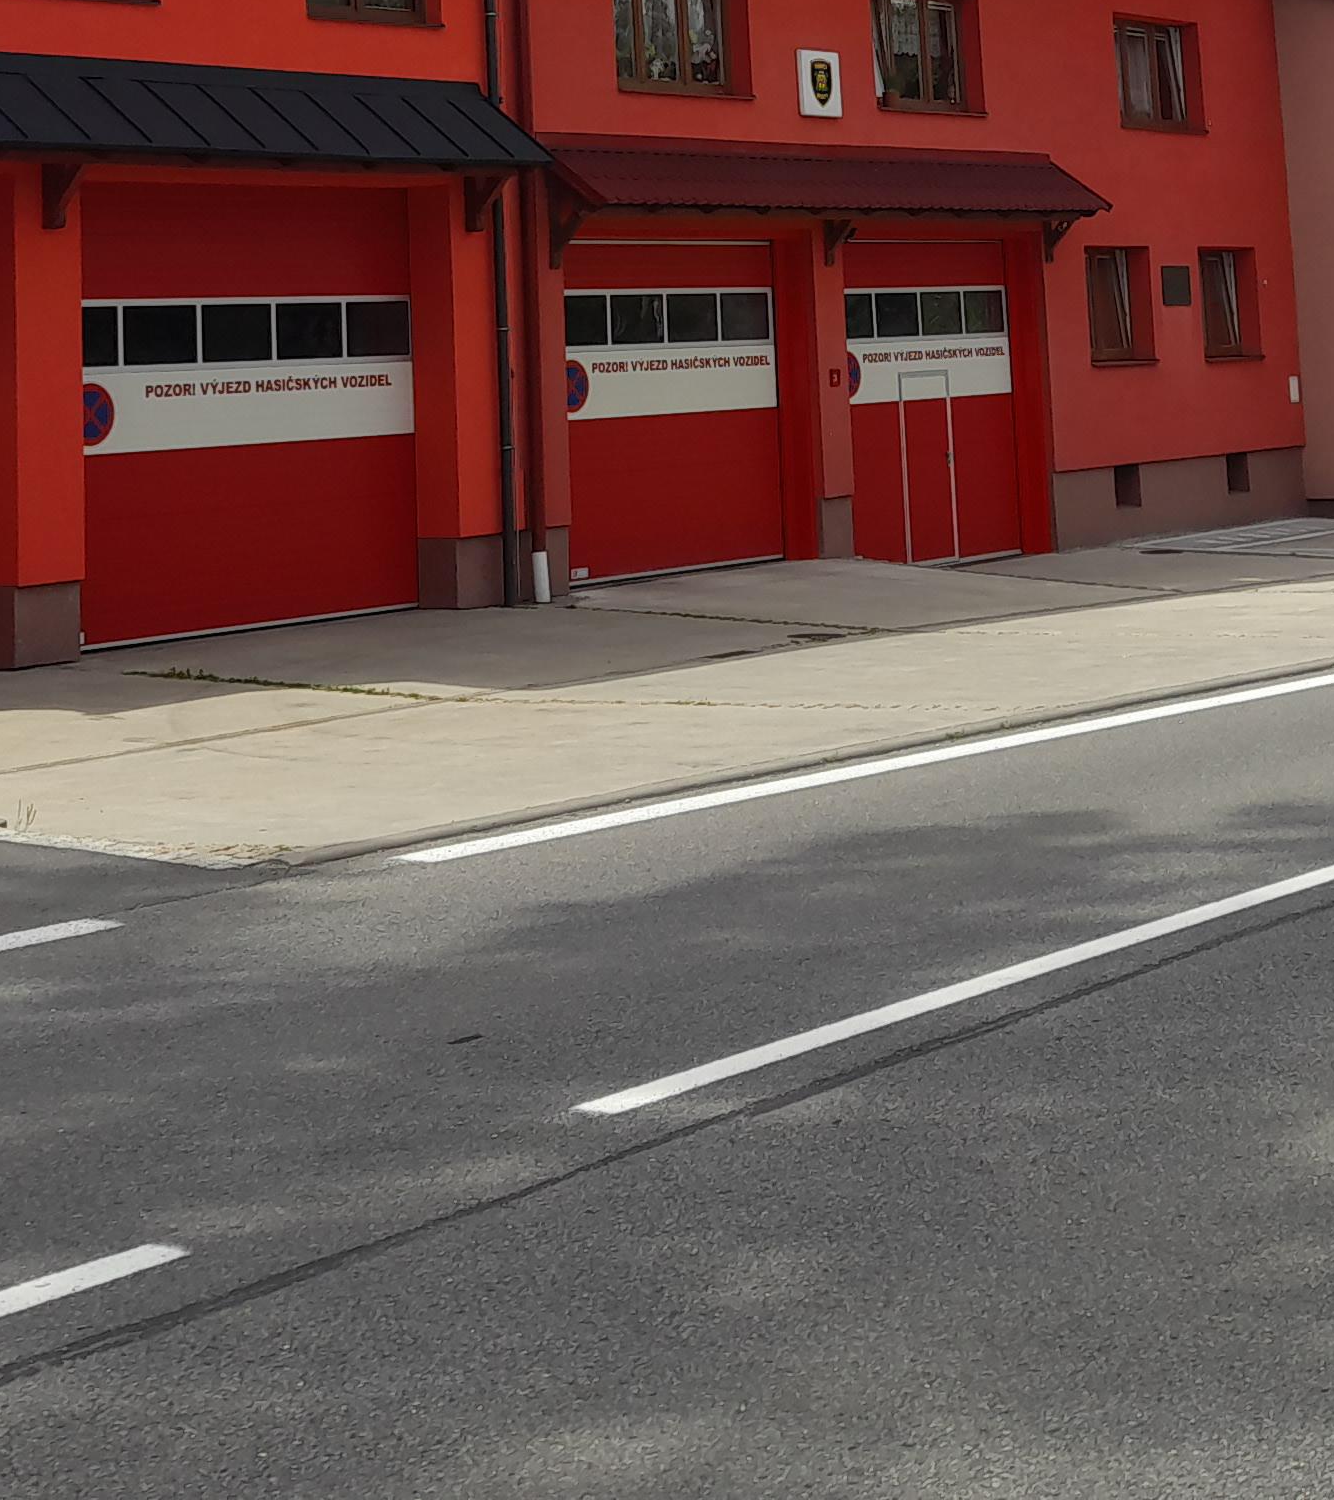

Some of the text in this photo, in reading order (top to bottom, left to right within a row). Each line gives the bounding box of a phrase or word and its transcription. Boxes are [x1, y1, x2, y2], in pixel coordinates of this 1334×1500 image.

[592, 354, 771, 373] POZOR! VÝJEZD HASIČSKÝCH VOZIDEL
[893, 350, 923, 362] VÝJEZD
[974, 346, 1005, 357] VOZIDEL
[145, 373, 392, 398] POZOR! VÝJEZD HASIČSKÝCH VOZIDEL
